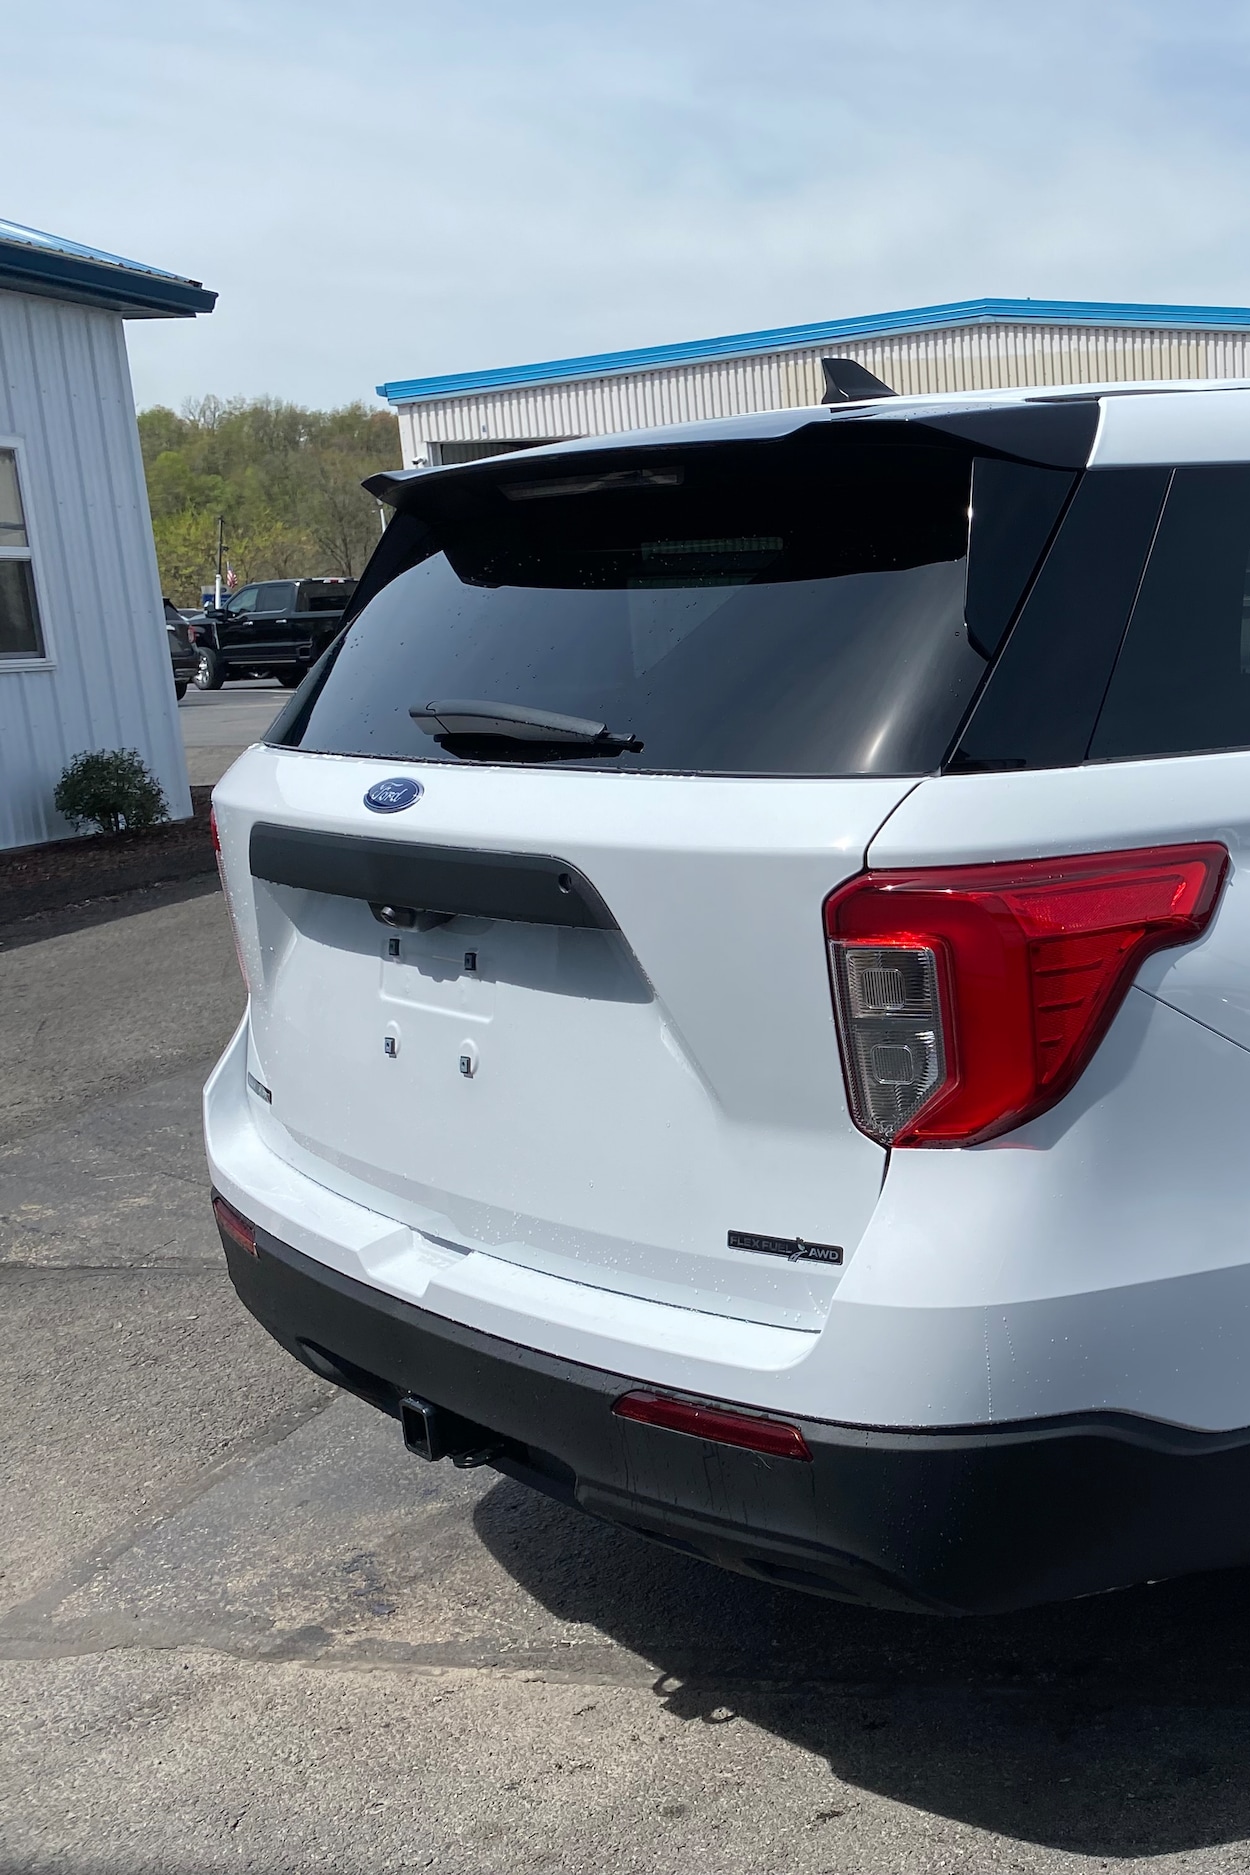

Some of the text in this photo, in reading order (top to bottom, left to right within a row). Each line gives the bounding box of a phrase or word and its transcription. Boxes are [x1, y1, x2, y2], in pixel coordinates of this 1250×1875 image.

[371, 781, 408, 803] Ford
[729, 1235, 839, 1261] FLEX FUEL AWD
